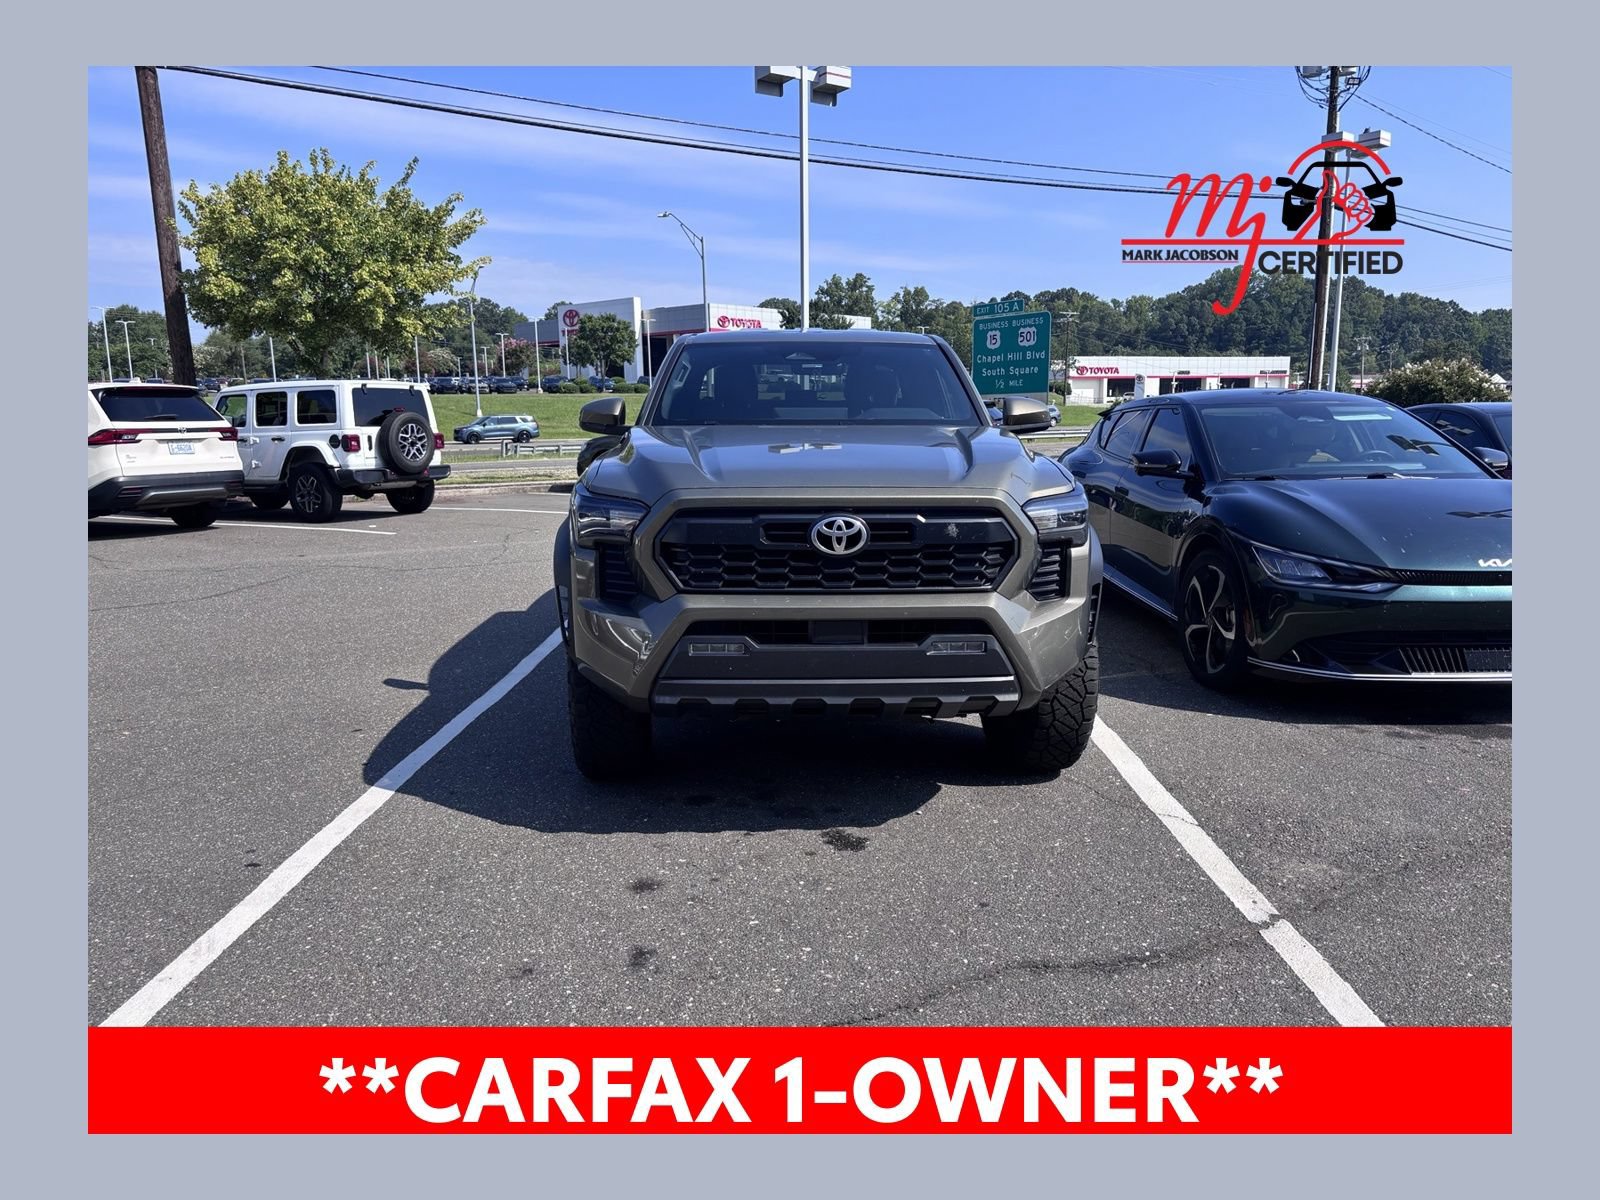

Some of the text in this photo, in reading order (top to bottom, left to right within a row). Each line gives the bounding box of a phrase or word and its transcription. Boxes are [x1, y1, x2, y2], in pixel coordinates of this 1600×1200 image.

[976, 302, 1020, 315] EXIT 105 A
[730, 317, 762, 329] TOYOTA
[979, 316, 1044, 330] BUSINESS BUSINESS
[989, 331, 1036, 346] 15 501
[976, 350, 1046, 364] Chapel Hill Blvd
[982, 366, 1039, 377] South Square
[1089, 366, 1120, 375] TOYOTA
[1009, 379, 1024, 387] MILE
